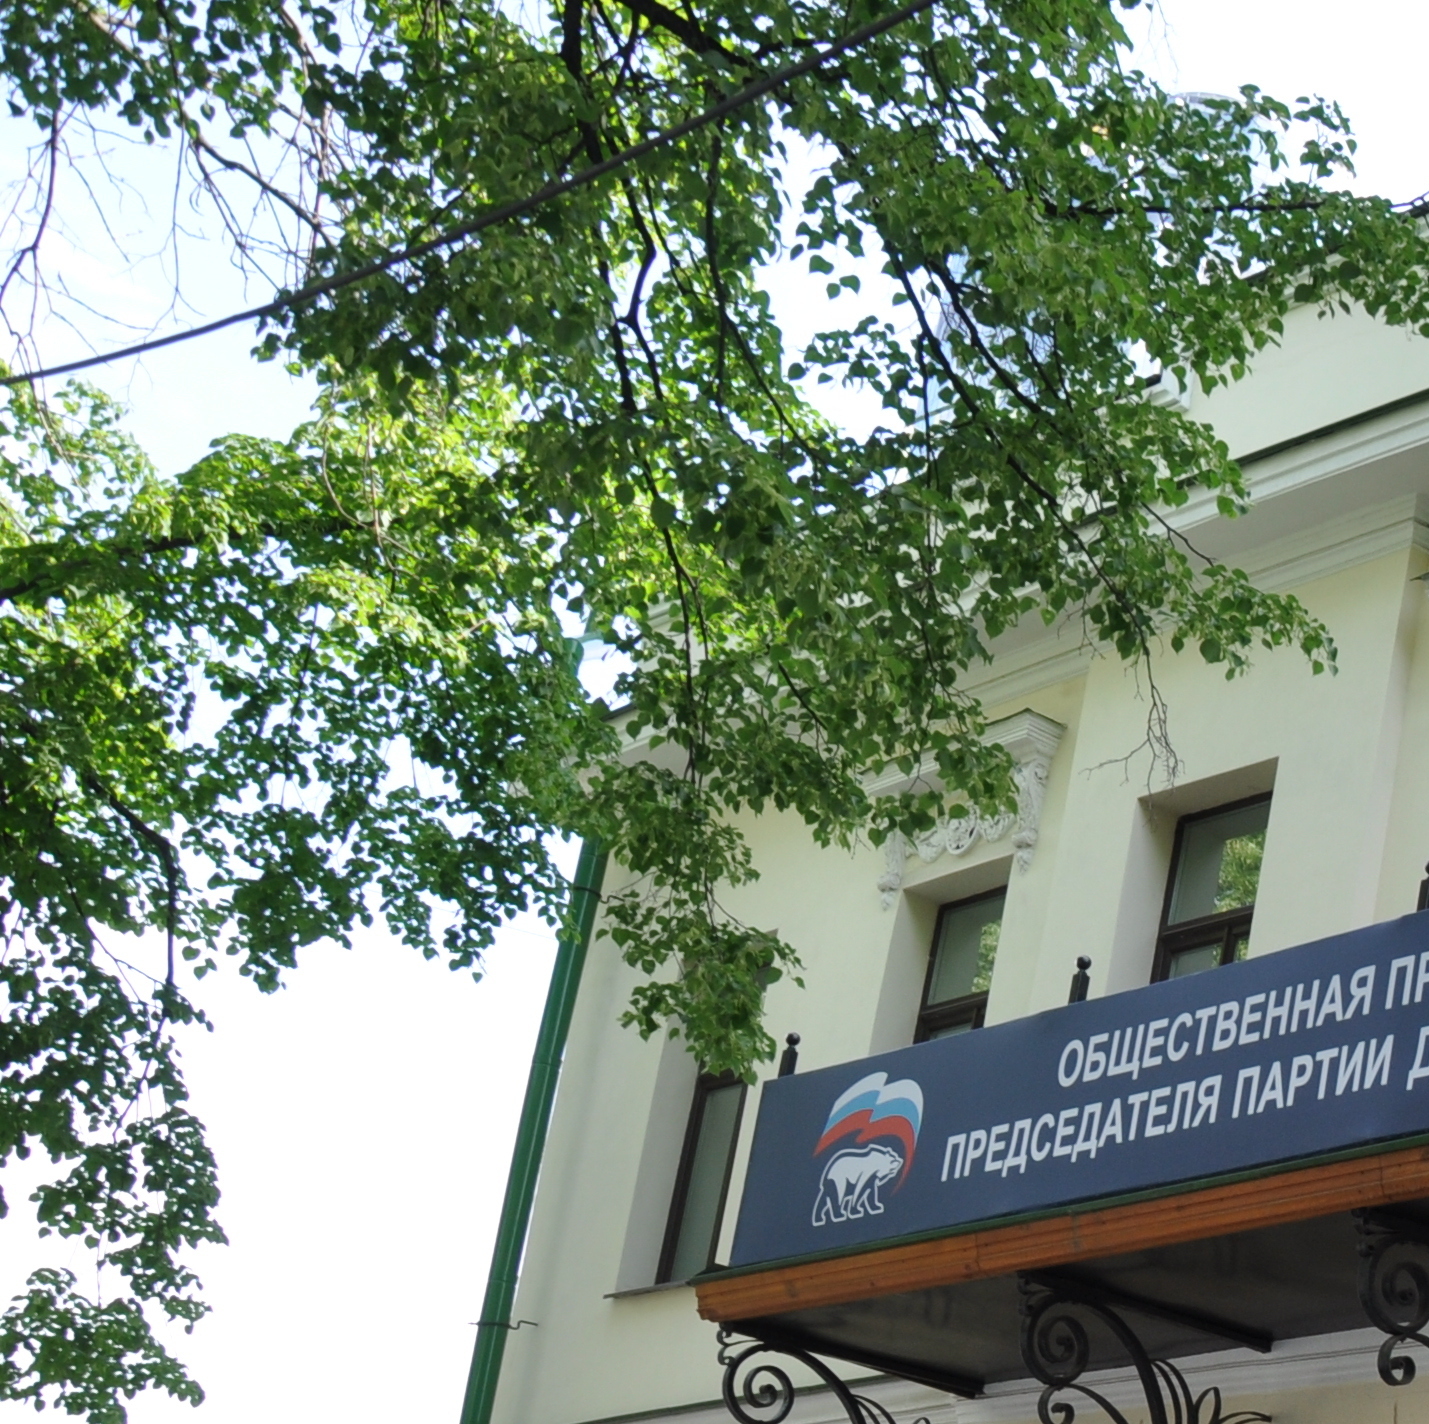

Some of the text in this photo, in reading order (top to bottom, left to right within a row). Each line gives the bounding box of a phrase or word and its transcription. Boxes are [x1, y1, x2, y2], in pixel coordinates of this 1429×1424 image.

[1058, 964, 1376, 1088] ОБЩЕСТВЕННАЯ
[940, 1074, 1222, 1182] ПРЕДСЕДАТЕЛЯ
[1231, 1034, 1395, 1119] ПАРТИИ
